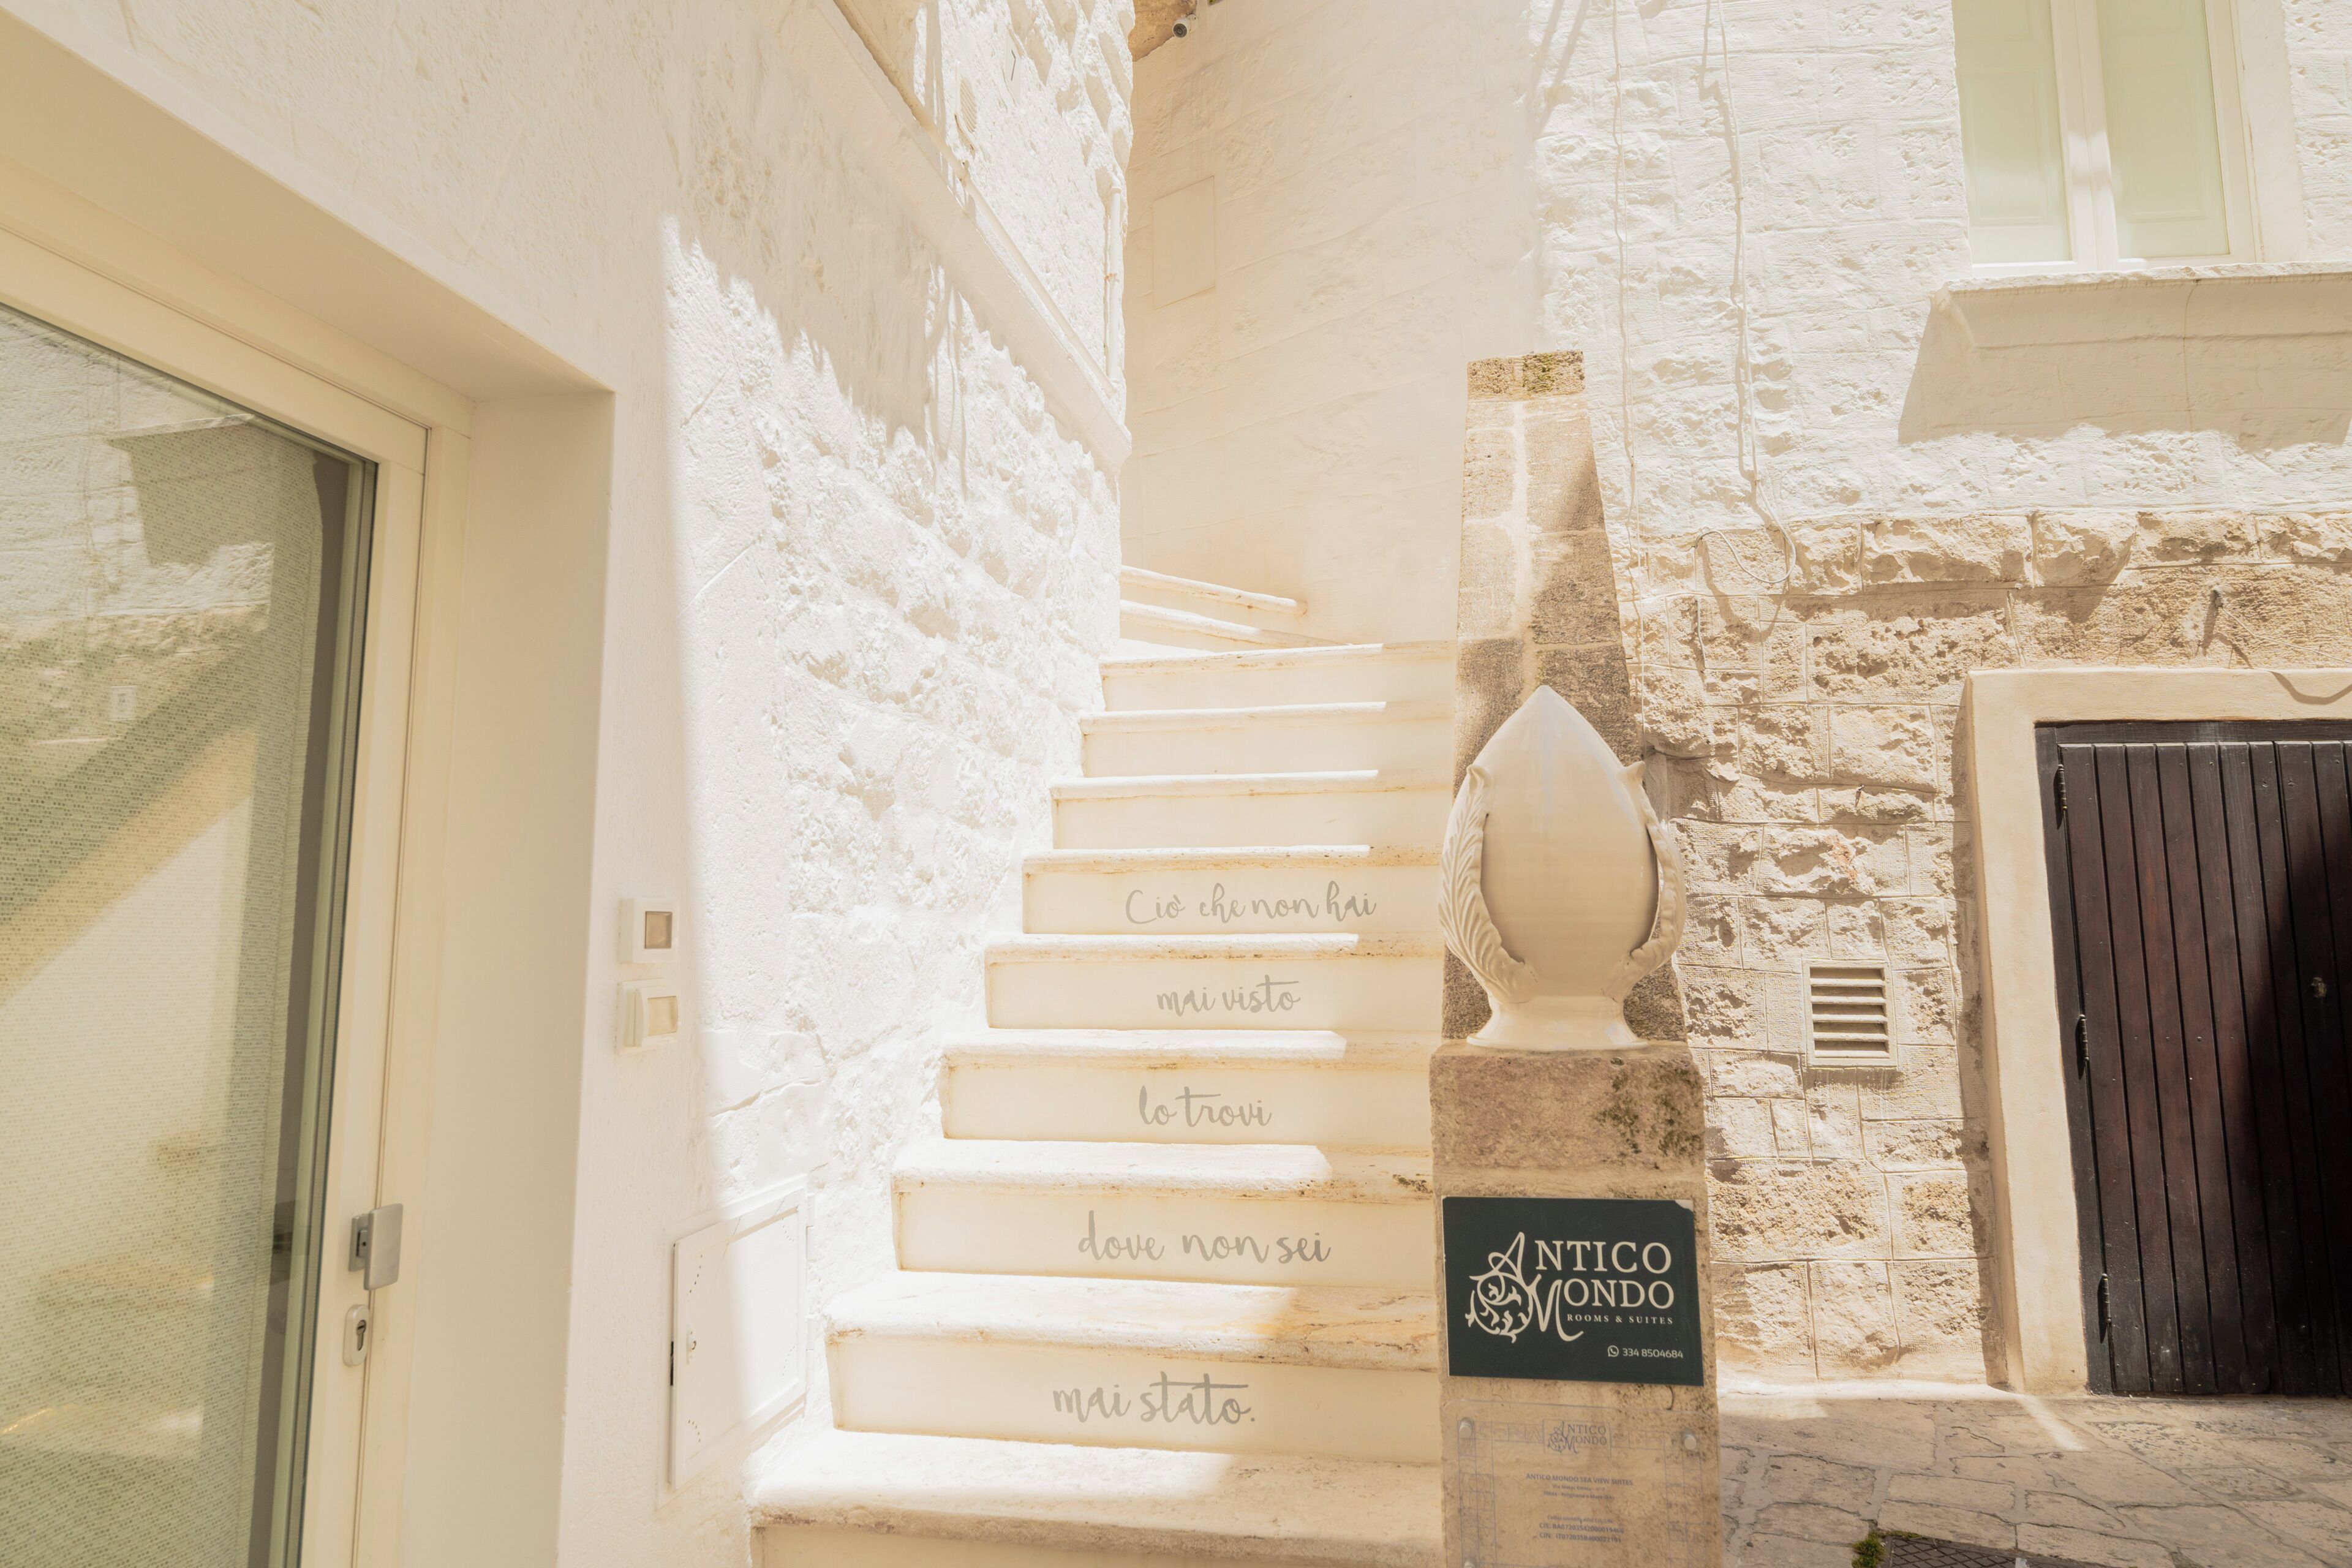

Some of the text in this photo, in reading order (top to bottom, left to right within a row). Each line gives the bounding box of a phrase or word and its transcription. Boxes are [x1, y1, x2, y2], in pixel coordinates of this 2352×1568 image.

[1125, 880, 1377, 924] Ciò che non hai
[1156, 974, 1301, 1017] mai visto
[1138, 1085, 1272, 1128] lo trovi
[1077, 1209, 1332, 1264] dove non sei
[1469, 1231, 1672, 1281] ANTICO
[1530, 1273, 1675, 1342] MONDO
[1567, 1313, 1673, 1325] ROOMS & SUITES
[1622, 1348, 1684, 1359] 334 8504684
[1052, 1370, 1256, 1425] mai stato.
